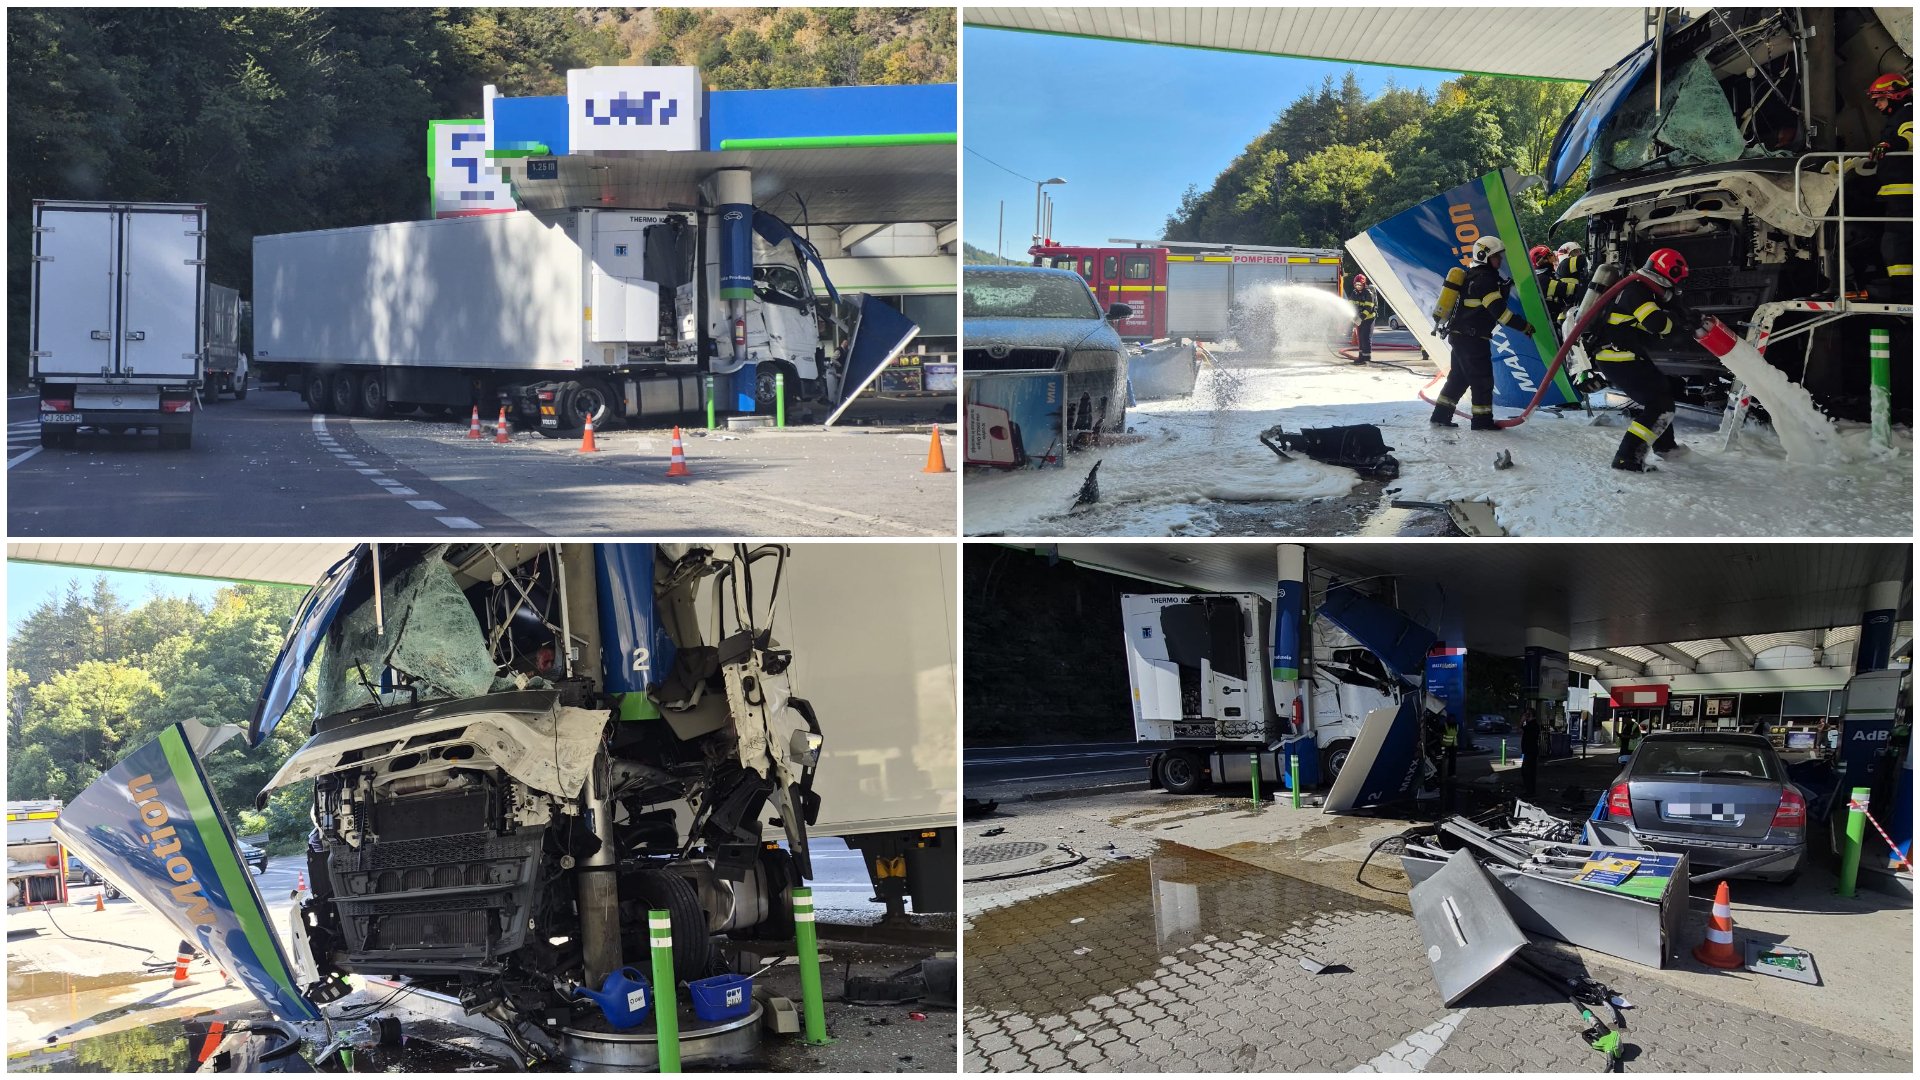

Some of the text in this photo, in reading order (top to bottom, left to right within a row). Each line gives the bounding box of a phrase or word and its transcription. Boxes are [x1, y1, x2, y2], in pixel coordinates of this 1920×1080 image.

[1448, 203, 1481, 268] tion
[1234, 256, 1287, 264] POMPIERII
[1046, 382, 1056, 404] VIVA
[633, 647, 650, 671] 2
[1852, 730, 1889, 741] AdB
[1400, 758, 1420, 792] MAXX
[128, 773, 217, 926] Motion
